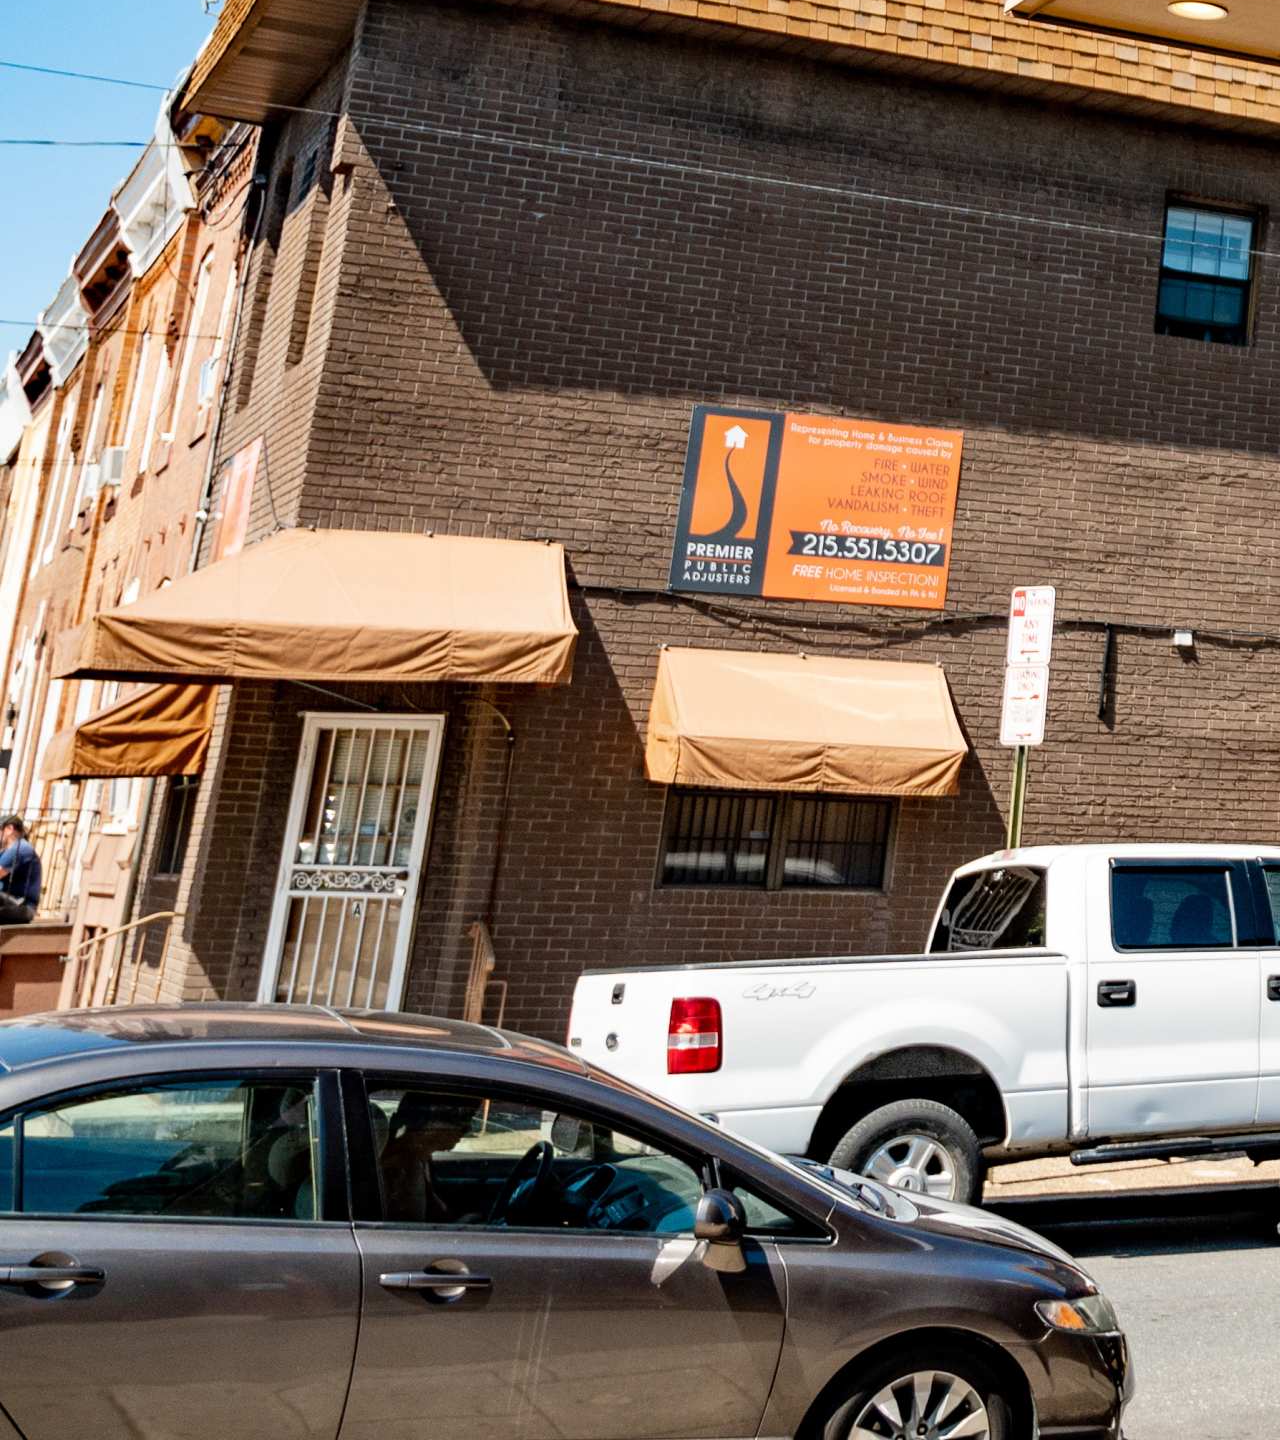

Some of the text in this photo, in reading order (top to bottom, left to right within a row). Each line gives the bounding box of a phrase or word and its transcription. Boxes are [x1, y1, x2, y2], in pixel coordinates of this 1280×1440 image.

[790, 422, 849, 439] Representing
[851, 429, 875, 440] Home
[887, 433, 923, 446] Business
[926, 437, 953, 449] Claims
[808, 436, 952, 460] for property damage caused by
[874, 458, 950, 476] FIRE WATER
[861, 472, 949, 490] SMOKE WIND
[850, 485, 948, 504] LEAKING ROOF
[827, 497, 945, 518] VANDALISM THEFT
[820, 519, 838, 533] No
[898, 525, 917, 538] No
[687, 542, 754, 560] PREMIER
[802, 533, 941, 564] 215.551.5307
[684, 560, 752, 574] PUBLIC
[792, 564, 823, 578] FREE
[825, 568, 863, 582] HOME
[683, 571, 751, 584] ADJUSTERS
